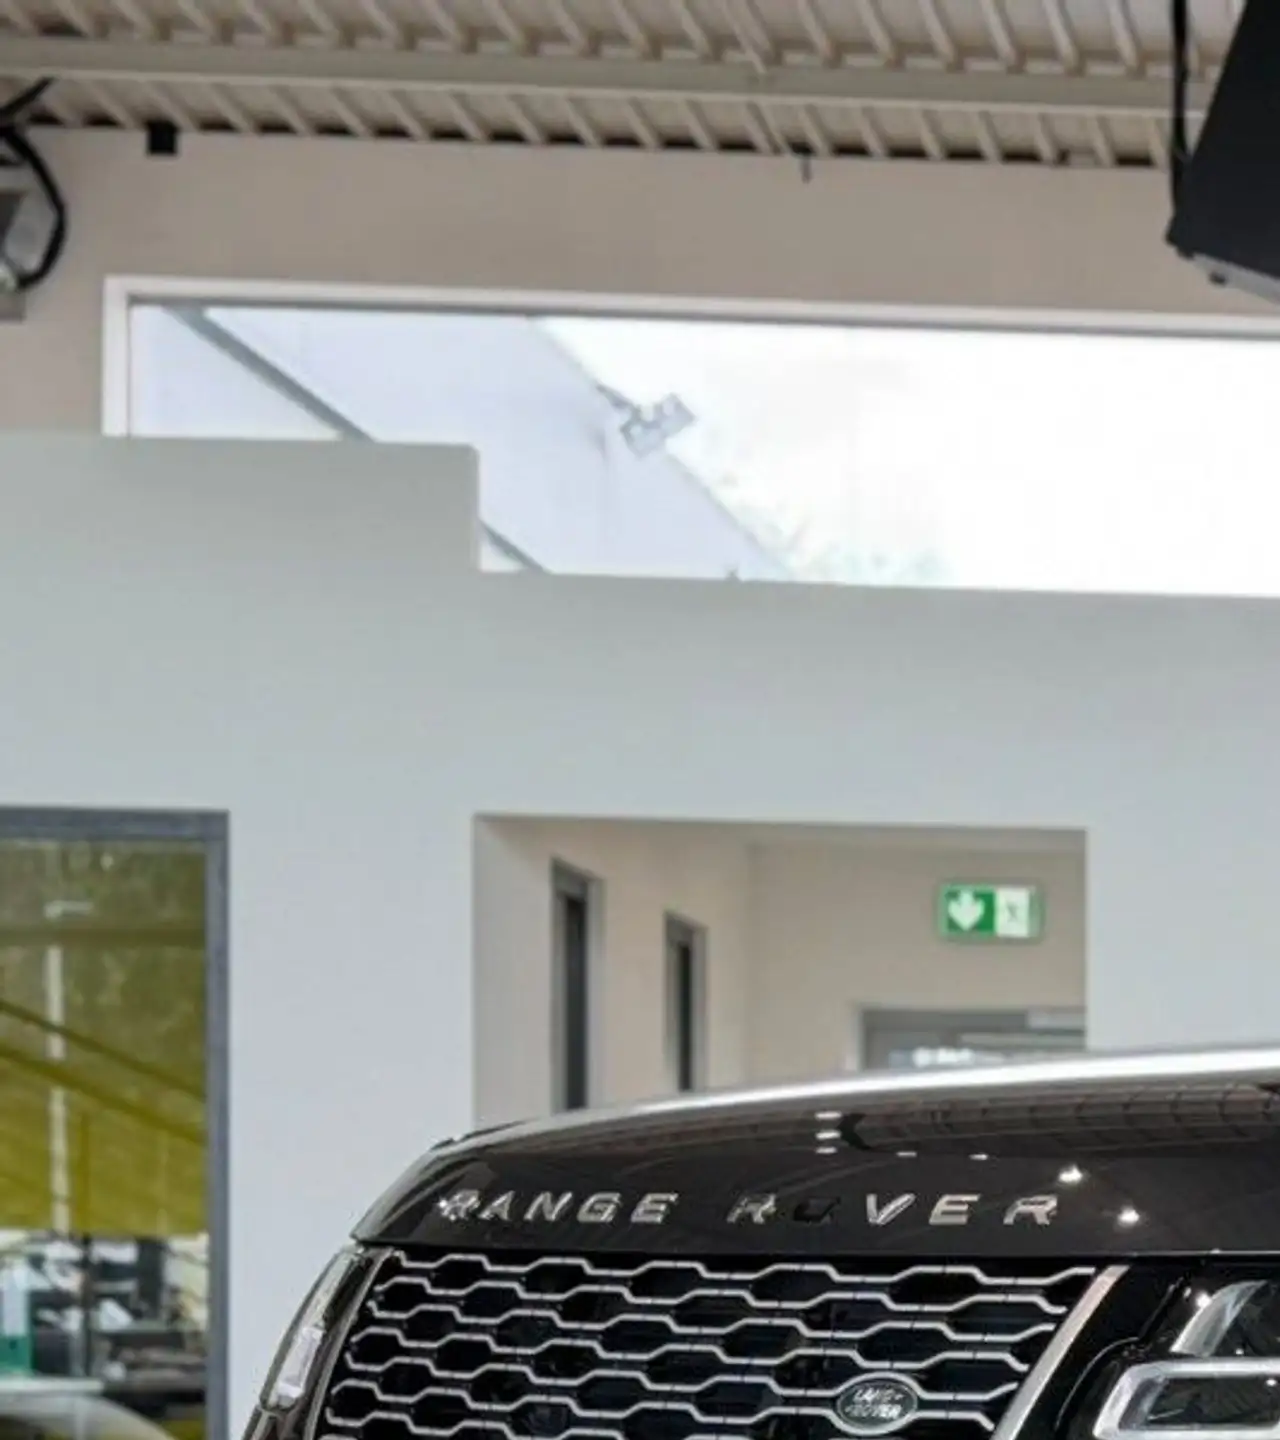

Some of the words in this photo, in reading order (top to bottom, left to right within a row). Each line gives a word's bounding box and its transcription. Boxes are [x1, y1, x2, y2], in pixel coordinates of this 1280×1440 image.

[438, 1190, 678, 1223] RANGE
[726, 1193, 1058, 1226] ROVER
[852, 1387, 896, 1403] LAND
[850, 1403, 902, 1418] ROVER
